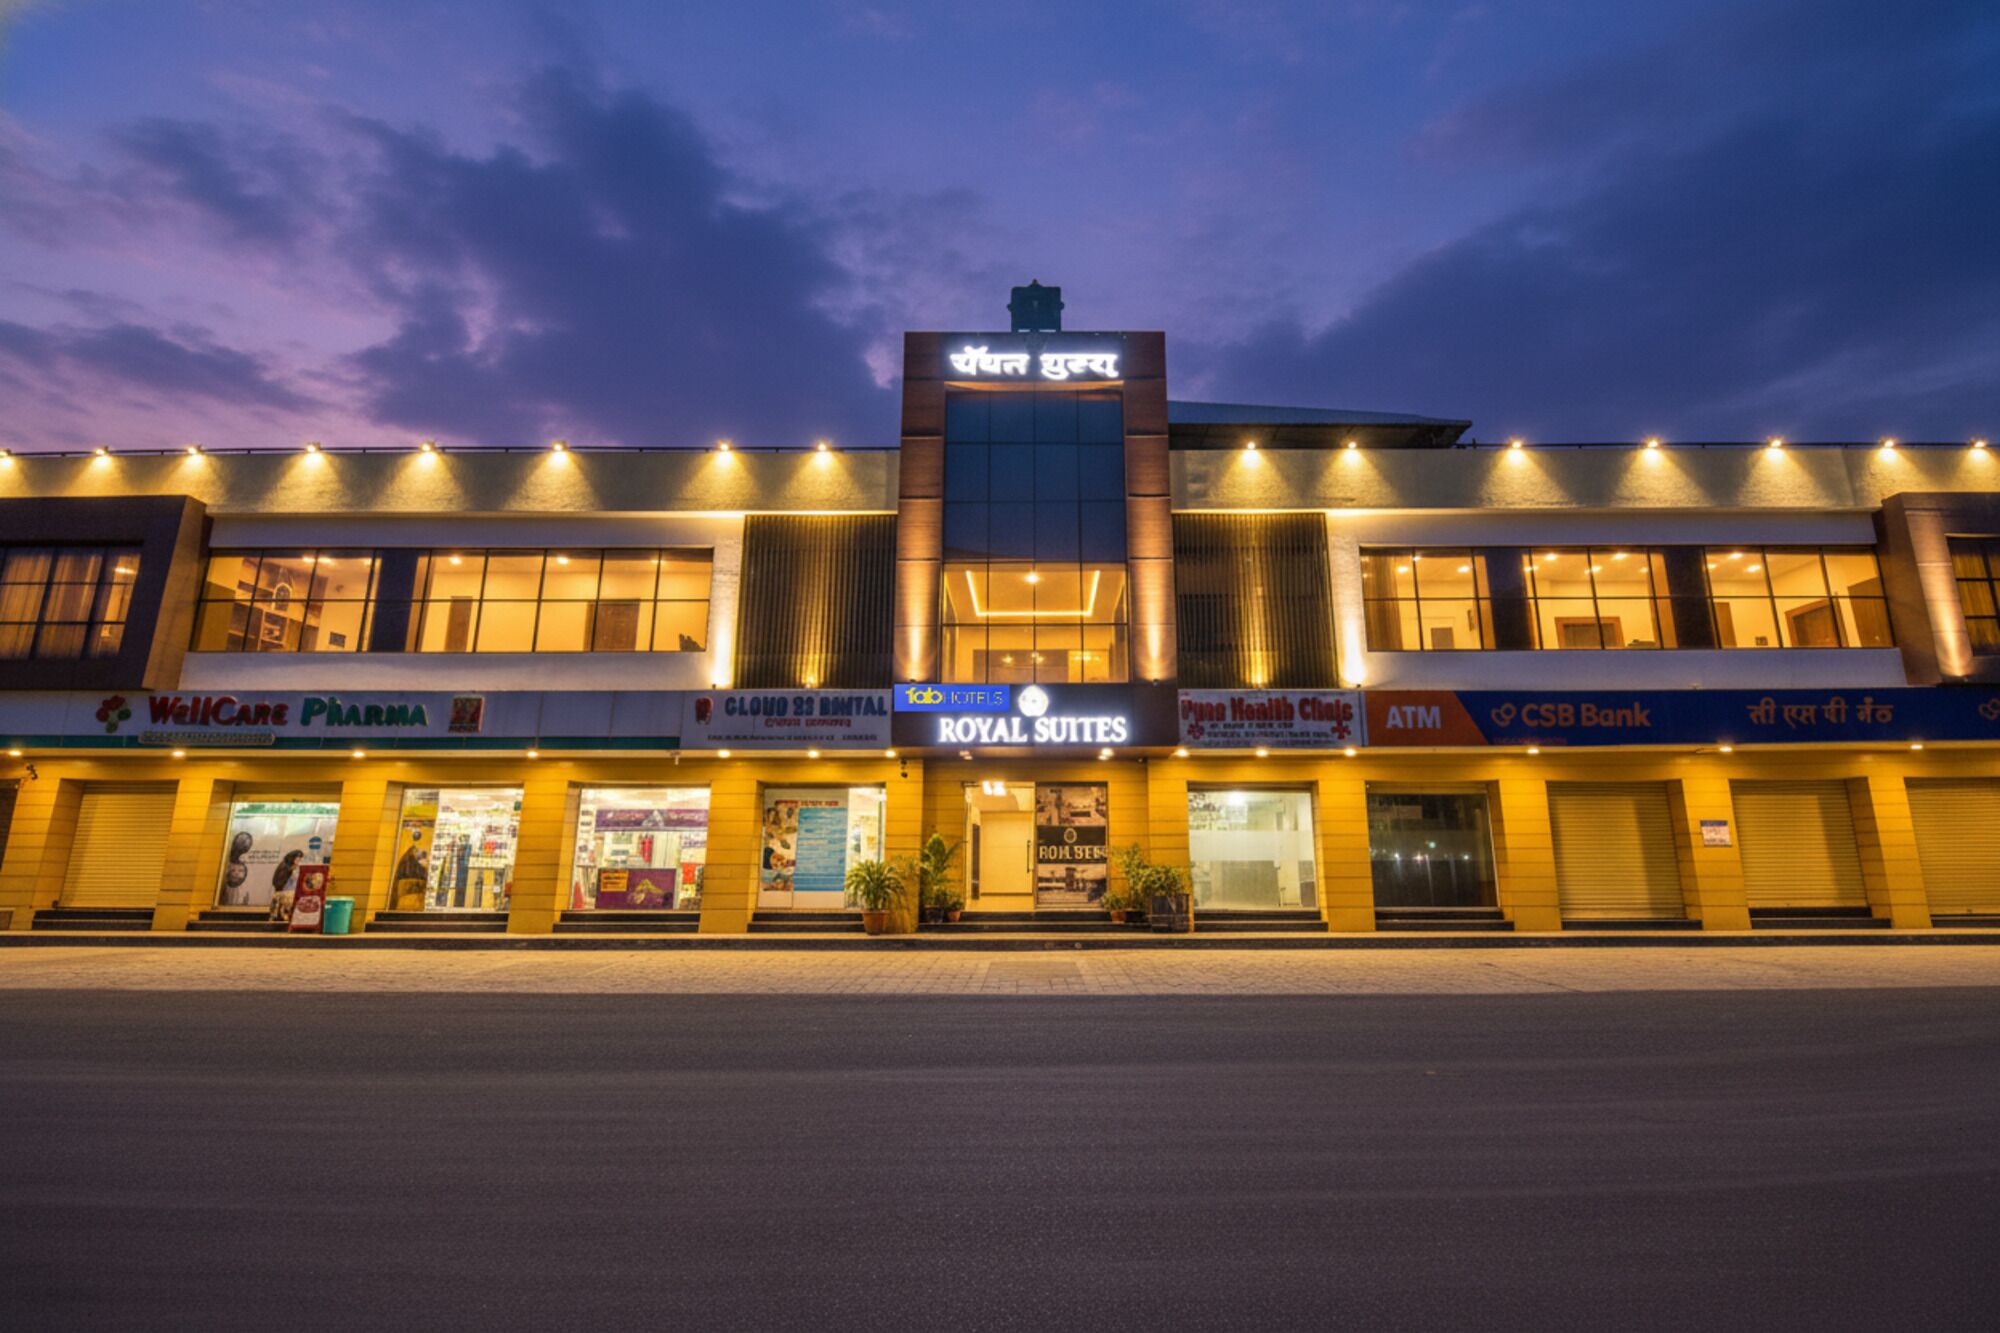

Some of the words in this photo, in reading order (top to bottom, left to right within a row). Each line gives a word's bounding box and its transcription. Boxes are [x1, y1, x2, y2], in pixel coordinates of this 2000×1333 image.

[725, 696, 788, 717] CLOUD
[1386, 706, 1441, 729] ATM
[1521, 703, 1575, 727] CSB
[1581, 702, 1650, 727] Bank
[938, 716, 1028, 743] ROYAL
[1034, 716, 1128, 743] SUITES
